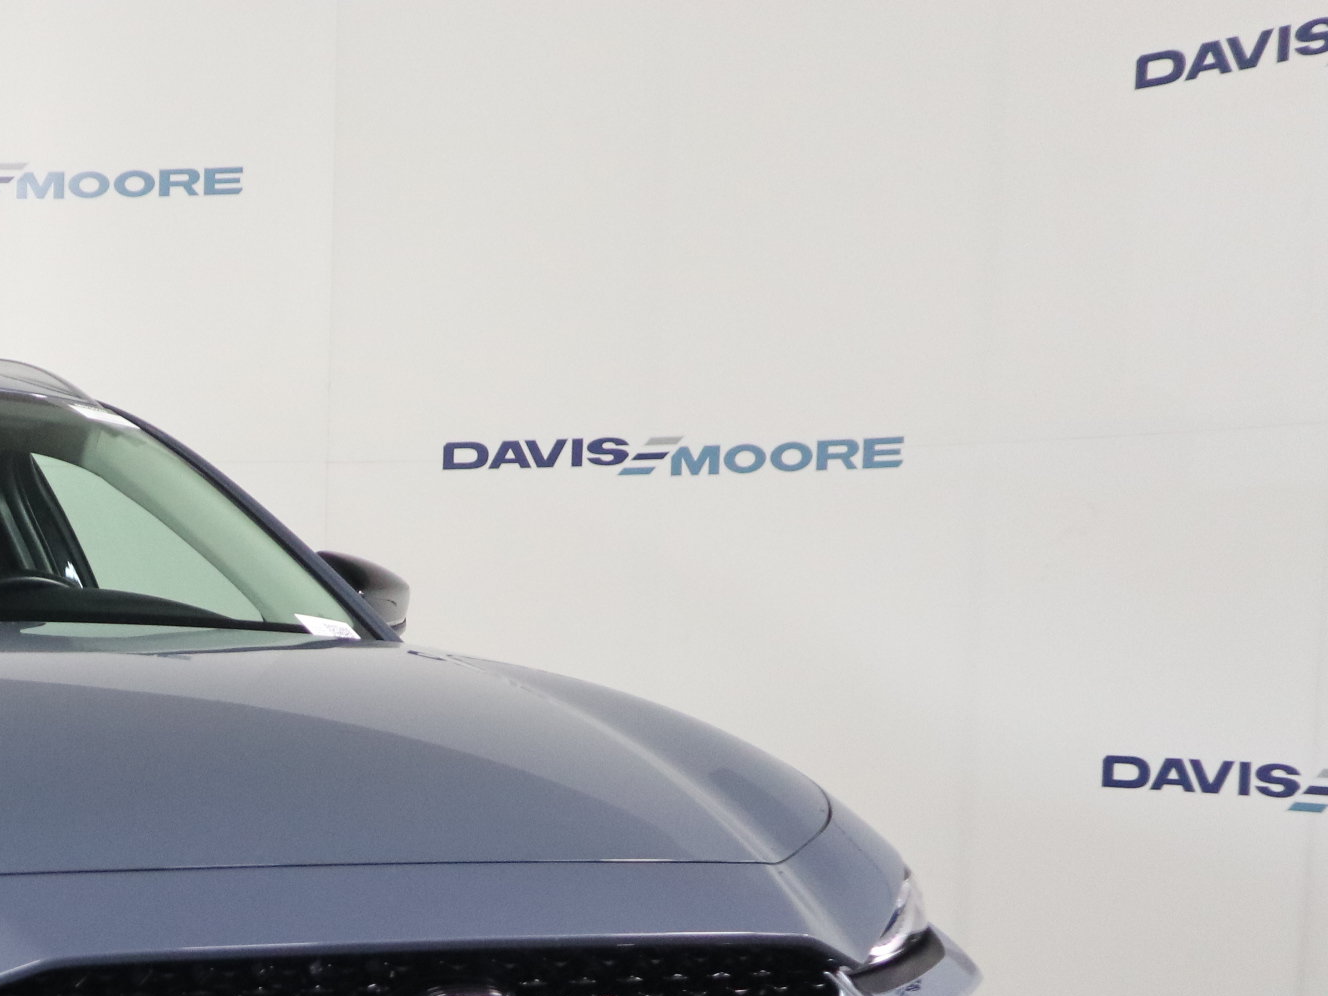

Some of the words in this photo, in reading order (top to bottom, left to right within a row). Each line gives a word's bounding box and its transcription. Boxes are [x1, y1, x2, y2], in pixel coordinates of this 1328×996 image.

[1134, 16, 1328, 90] DAVIS
[15, 166, 244, 200] MOORE
[441, 436, 630, 471] DAVIS
[670, 435, 905, 476] MOORE
[1101, 754, 1302, 799] DAVIS
